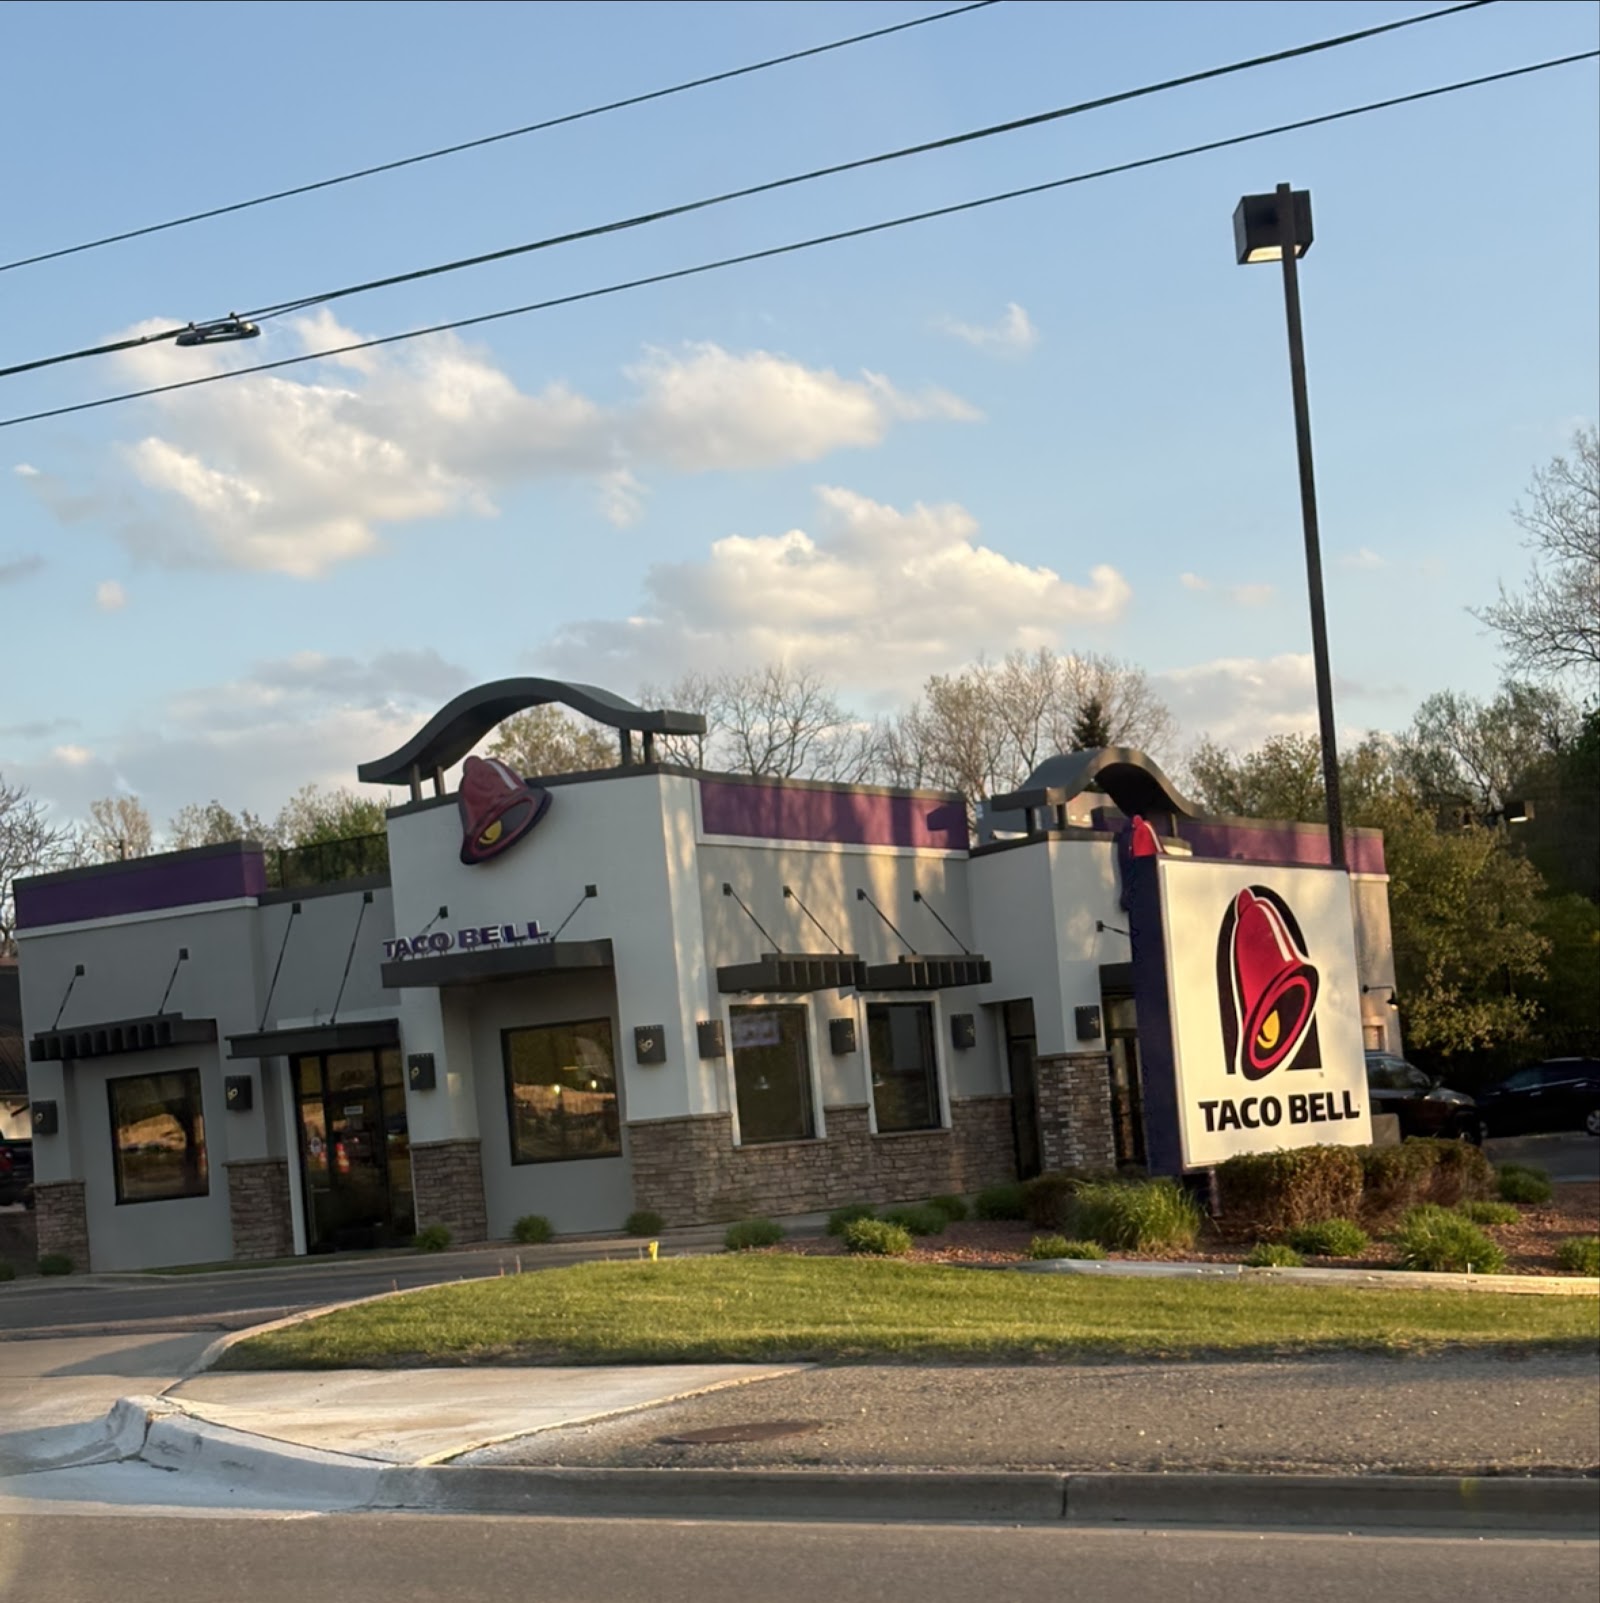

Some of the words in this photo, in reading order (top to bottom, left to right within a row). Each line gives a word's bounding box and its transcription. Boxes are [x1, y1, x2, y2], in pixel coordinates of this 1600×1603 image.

[383, 932, 454, 959] TACO
[458, 920, 550, 948] BELL
[1198, 1096, 1282, 1132] TACO
[1288, 1090, 1360, 1124] BELL
